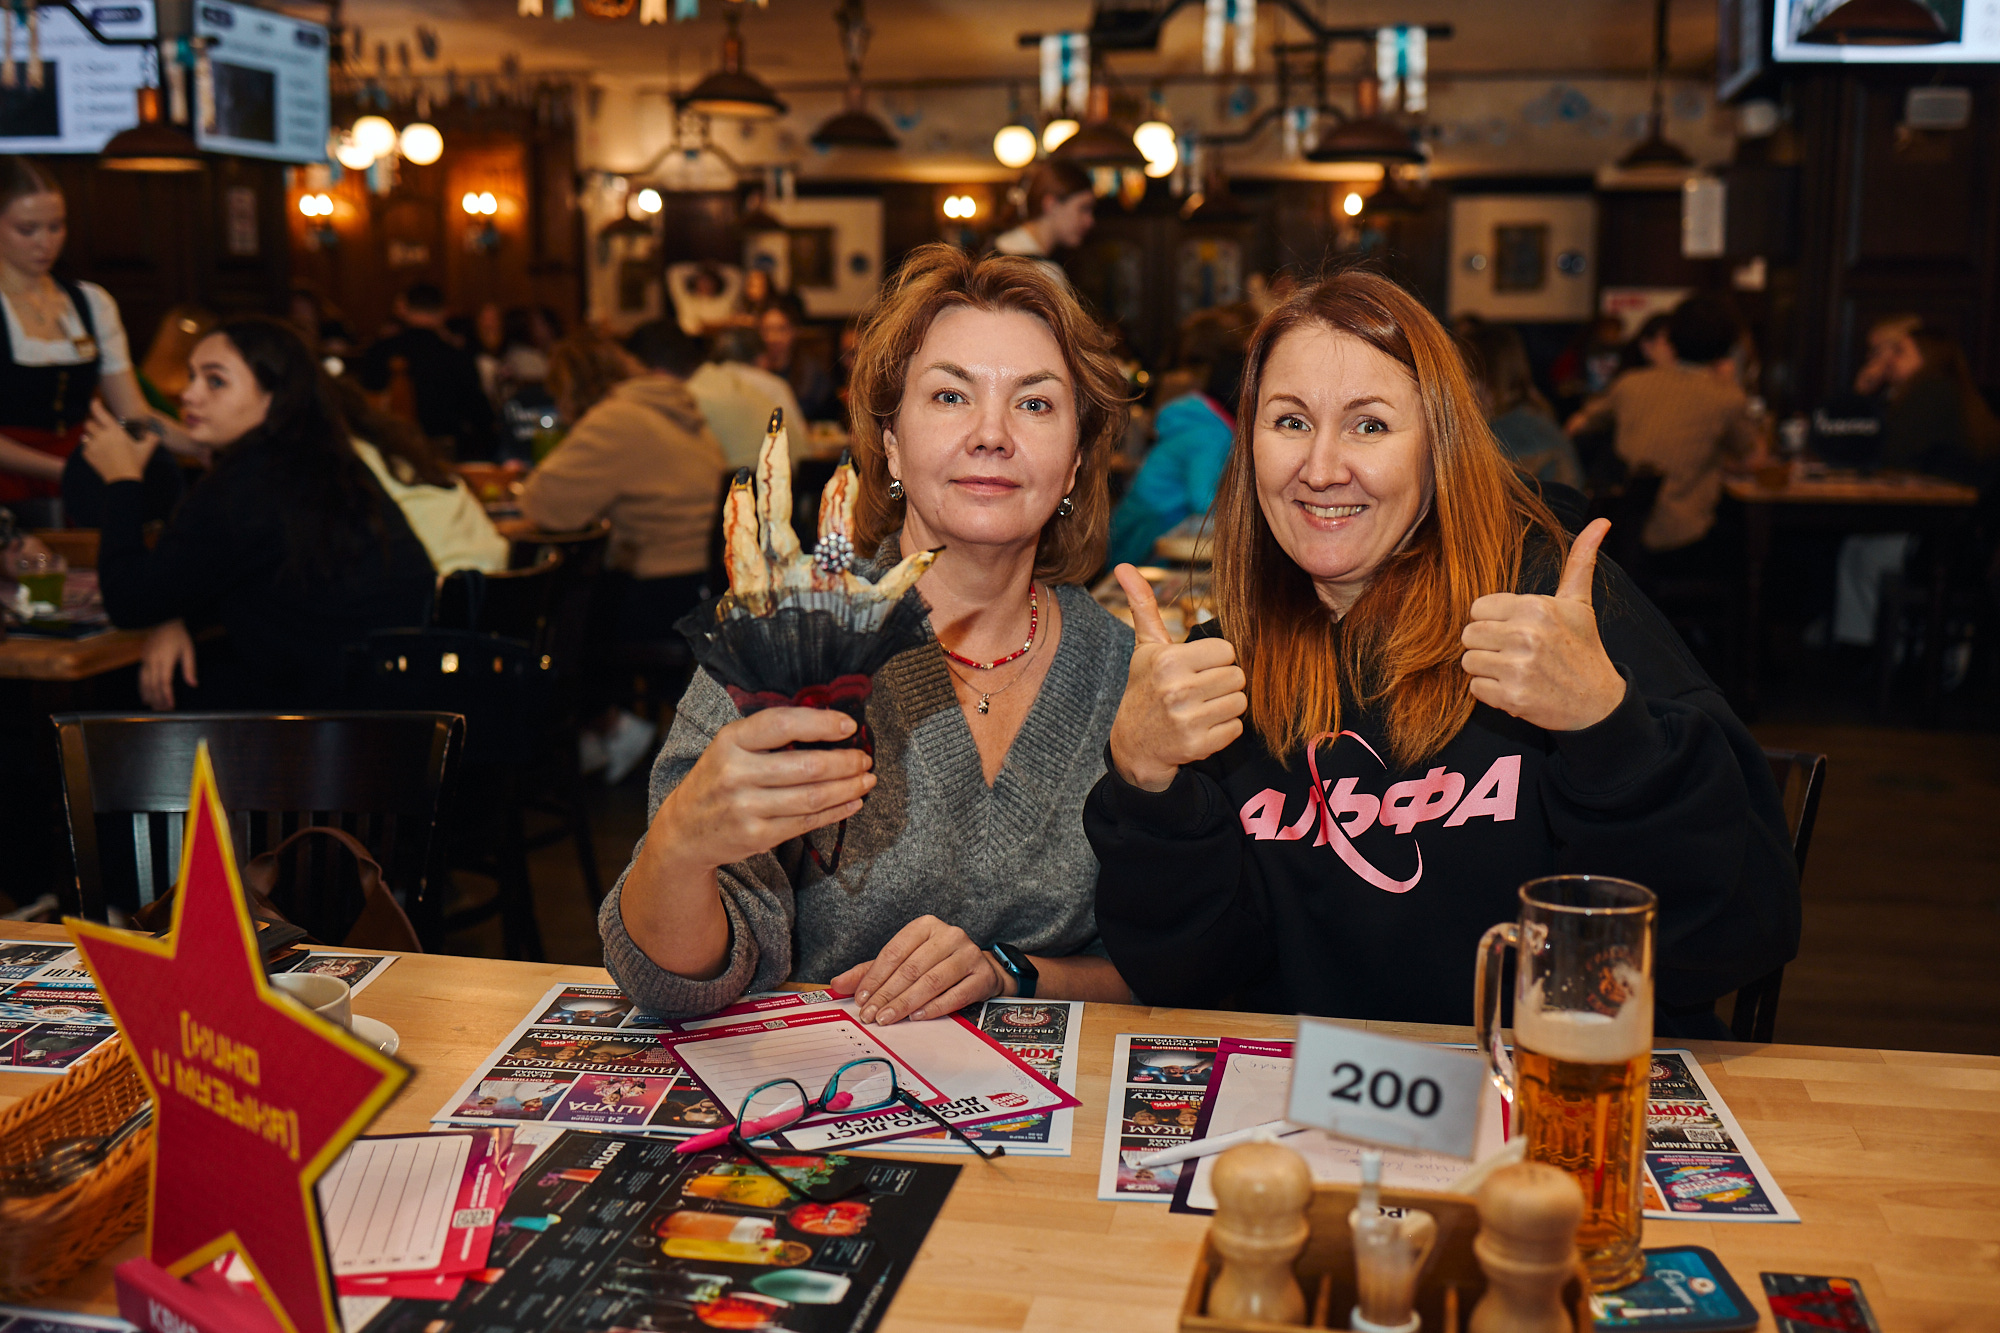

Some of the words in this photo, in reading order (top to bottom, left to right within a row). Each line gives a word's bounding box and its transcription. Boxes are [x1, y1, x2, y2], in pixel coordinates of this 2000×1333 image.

[1007, 1048, 1054, 1059] КОР
[503, 1059, 675, 1074] ИМЕНИННИКАМ
[1331, 1061, 1443, 1118] 200
[568, 1101, 645, 1115] ШУРА
[894, 1105, 990, 1127] ПРОТО
[833, 1109, 914, 1130] АПИСИ
[826, 1122, 888, 1141] ЛИСТ
[1651, 1141, 1701, 1150] ДЕКАБРЯ
